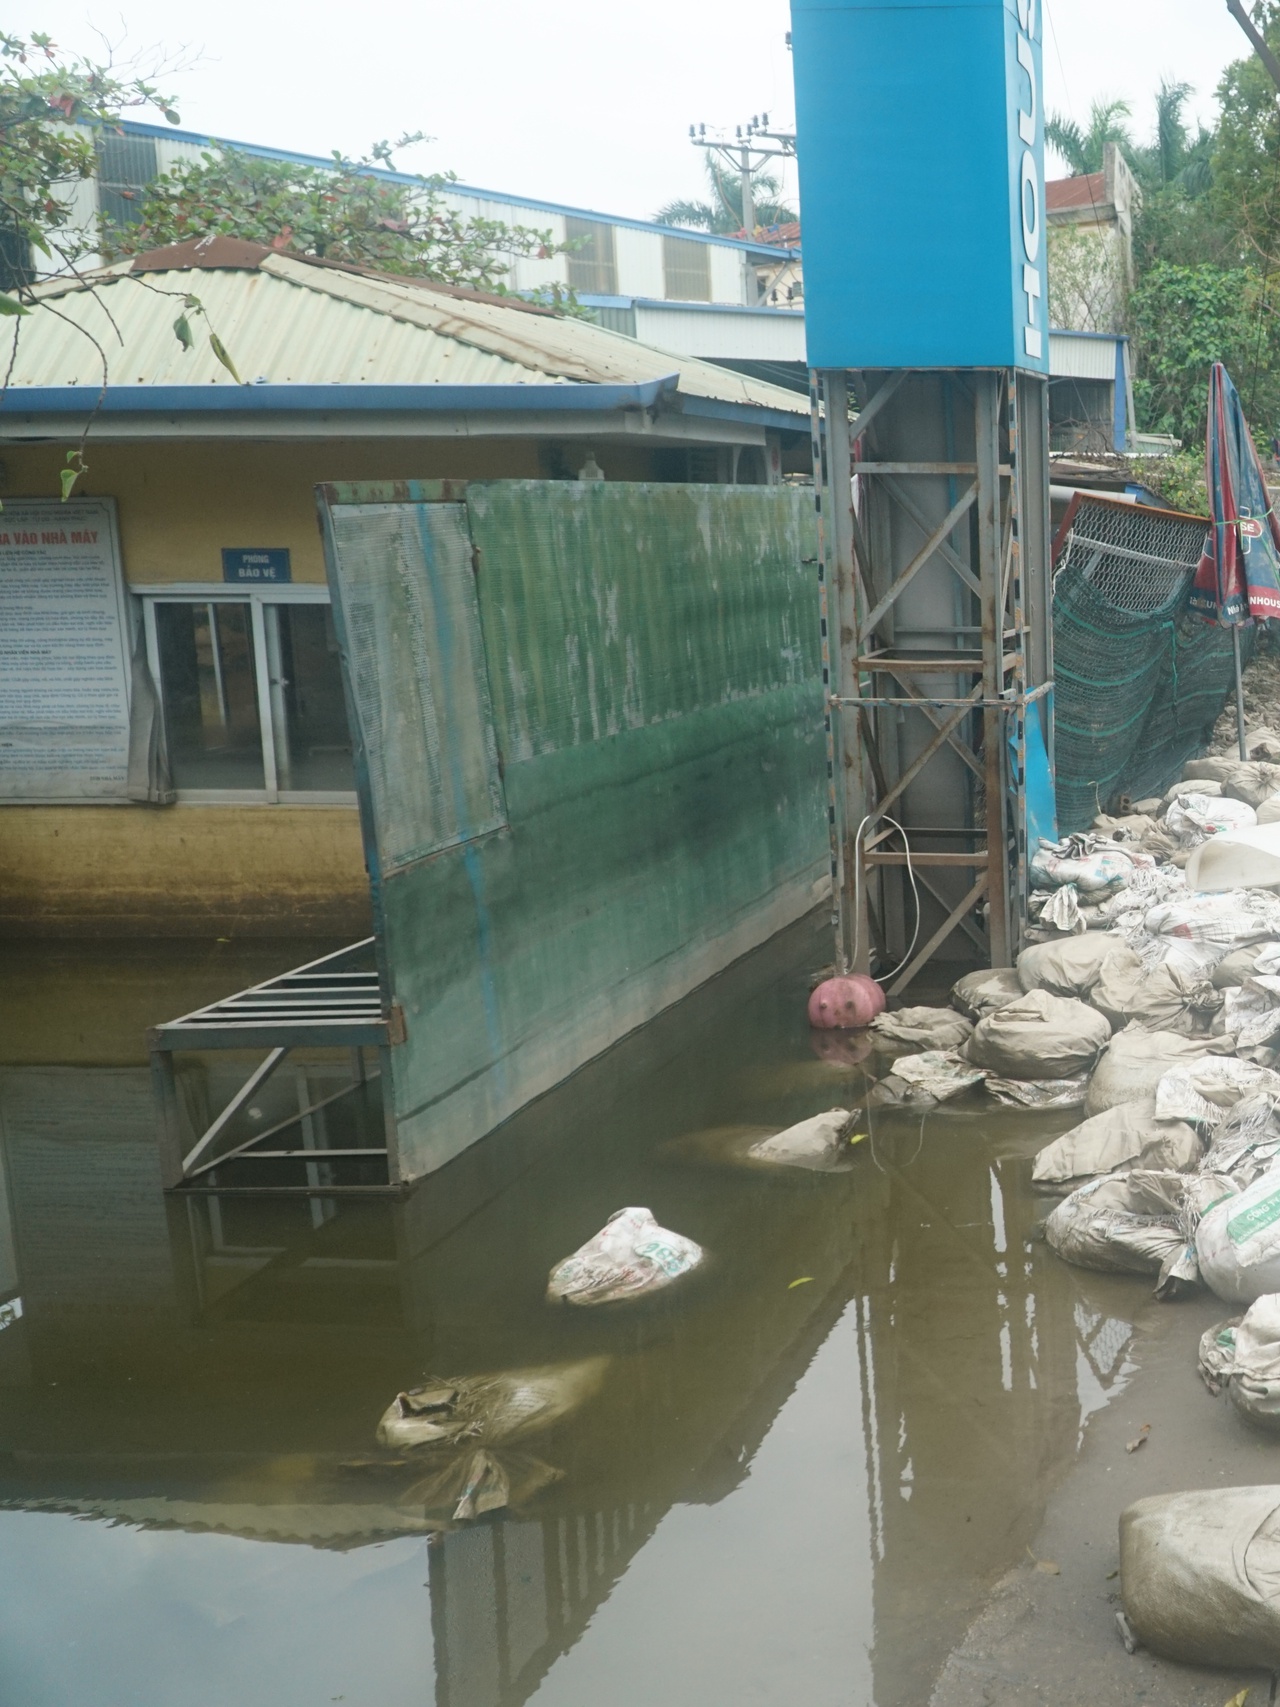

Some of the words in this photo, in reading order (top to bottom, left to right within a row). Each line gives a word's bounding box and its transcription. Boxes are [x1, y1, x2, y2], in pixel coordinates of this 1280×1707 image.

[13, 529, 38, 545] VÀO
[41, 528, 67, 544] NHÀ
[71, 529, 98, 544] MÁY
[239, 565, 260, 577] BẢO
[1245, 1204, 1269, 1221] CÔNG
